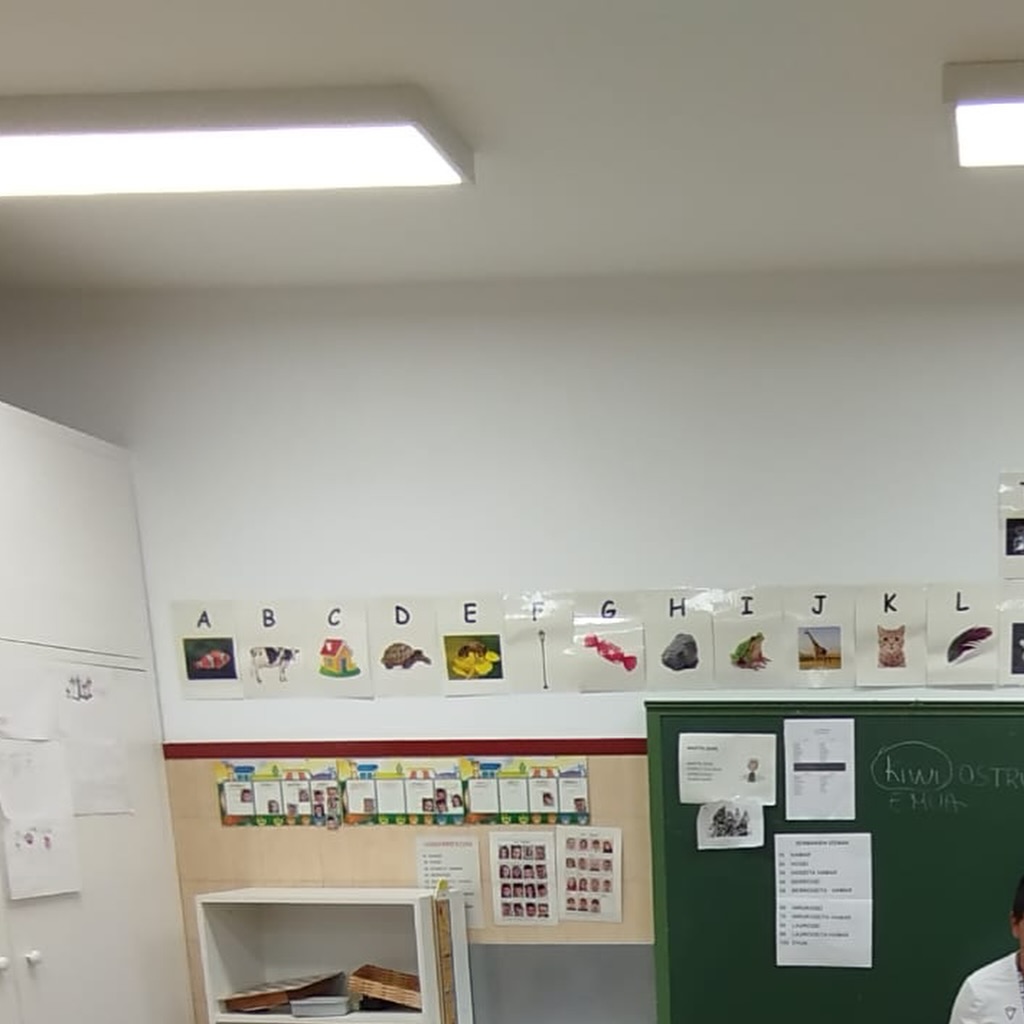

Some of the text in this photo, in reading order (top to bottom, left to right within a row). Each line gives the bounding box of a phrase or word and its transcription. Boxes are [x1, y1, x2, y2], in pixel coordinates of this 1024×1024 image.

[601, 599, 617, 619] G
[669, 598, 686, 618] H
[741, 596, 754, 615] I
[811, 594, 828, 615] J
[883, 593, 898, 613] K
[956, 592, 970, 612] L
[197, 609, 211, 628] A
[261, 607, 276, 628] B
[327, 607, 341, 627] C
[394, 605, 410, 626] D
[462, 602, 477, 624] E
